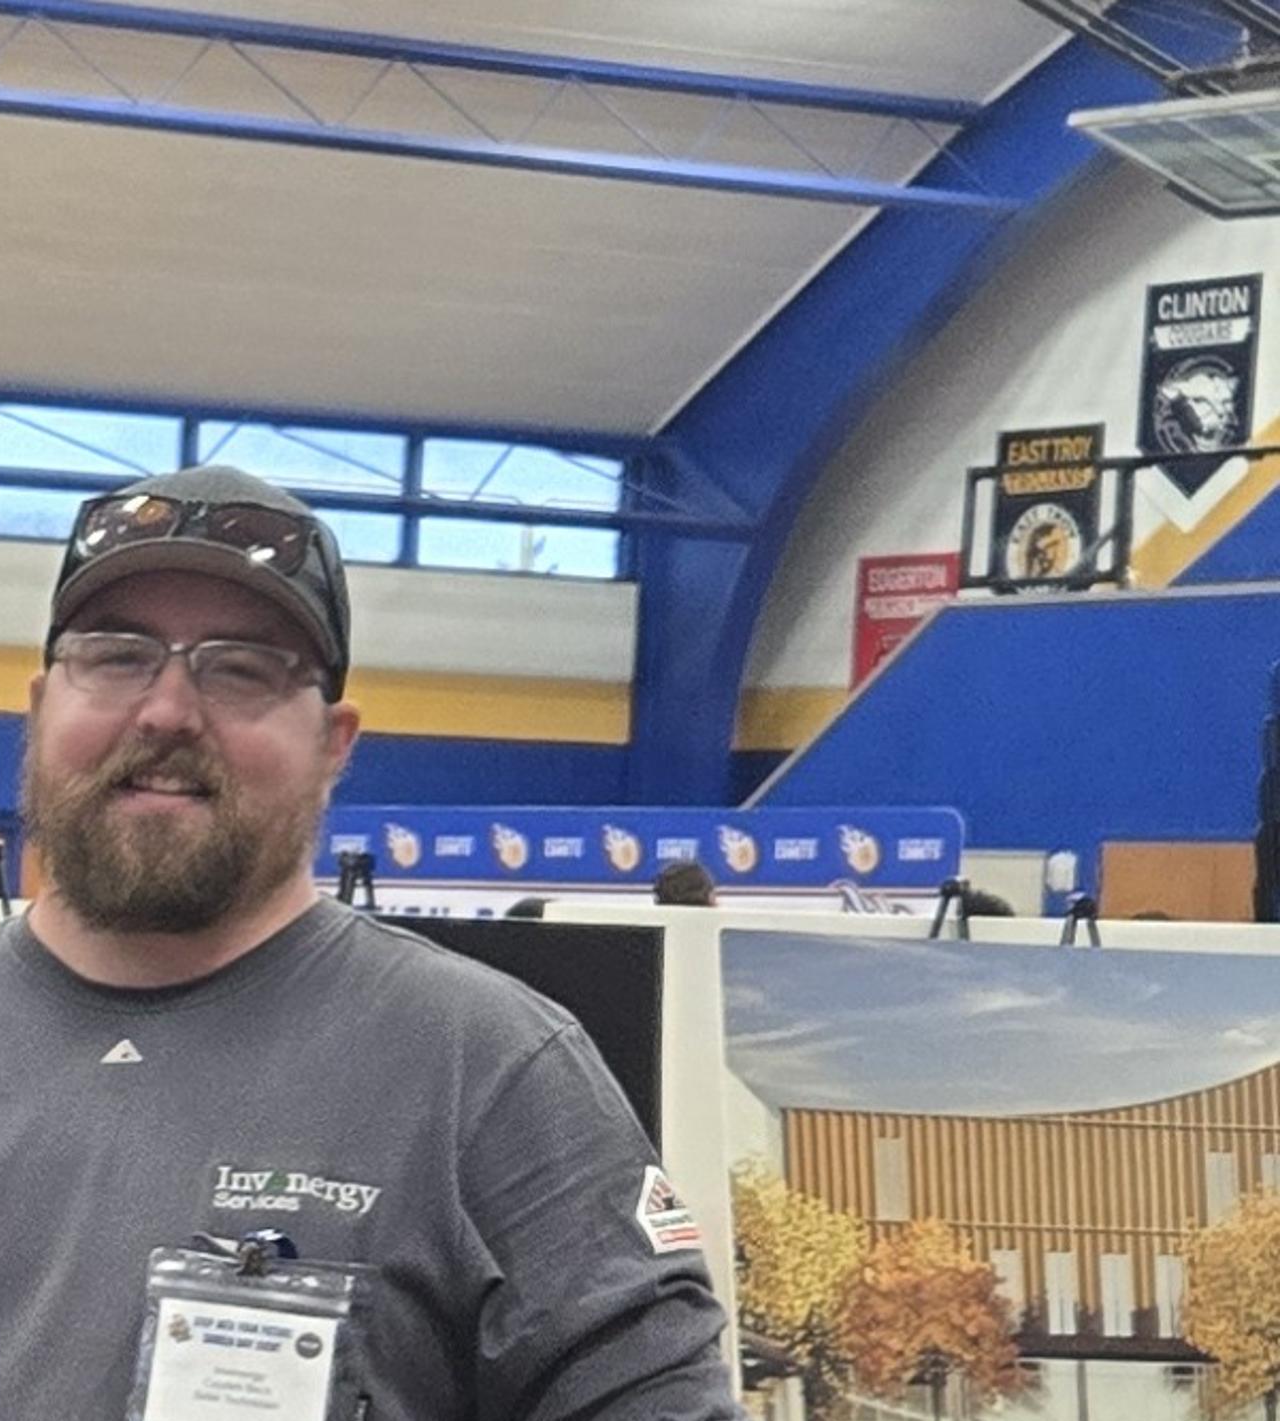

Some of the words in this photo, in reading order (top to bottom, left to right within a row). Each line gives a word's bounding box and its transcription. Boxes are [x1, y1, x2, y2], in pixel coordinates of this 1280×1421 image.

[1158, 286, 1249, 320] CLINTON
[1008, 438, 1051, 465] EAST
[1052, 436, 1093, 462] TROY
[212, 1191, 300, 1211] Services
